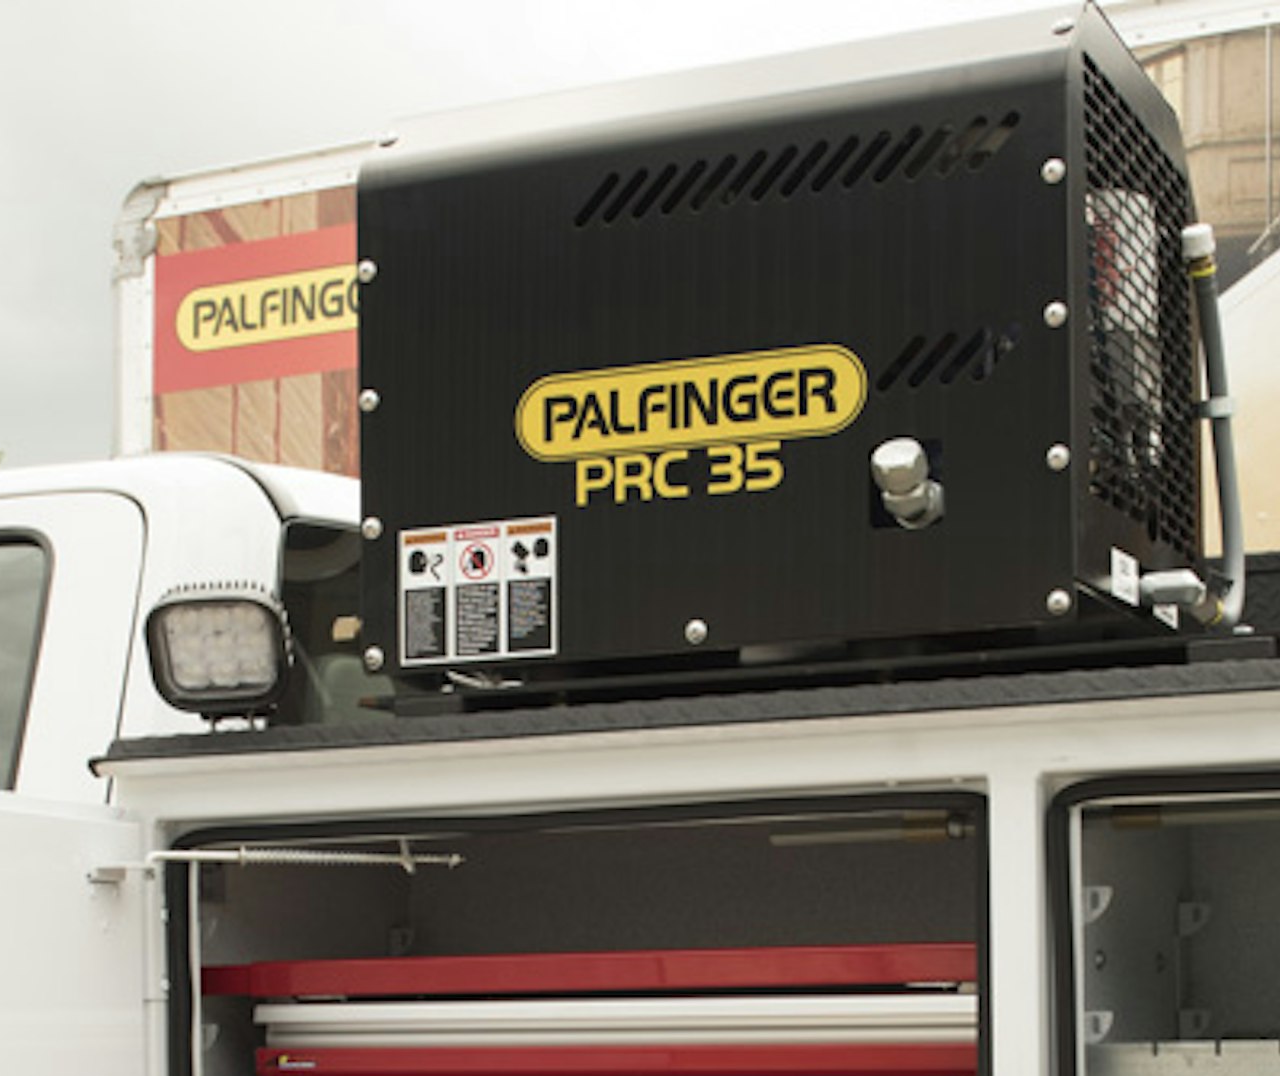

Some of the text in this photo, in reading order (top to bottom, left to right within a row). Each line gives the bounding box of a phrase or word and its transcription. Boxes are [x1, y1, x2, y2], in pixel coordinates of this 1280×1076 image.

[542, 367, 838, 443] PALFINGER
[575, 440, 785, 507] PRC 35
